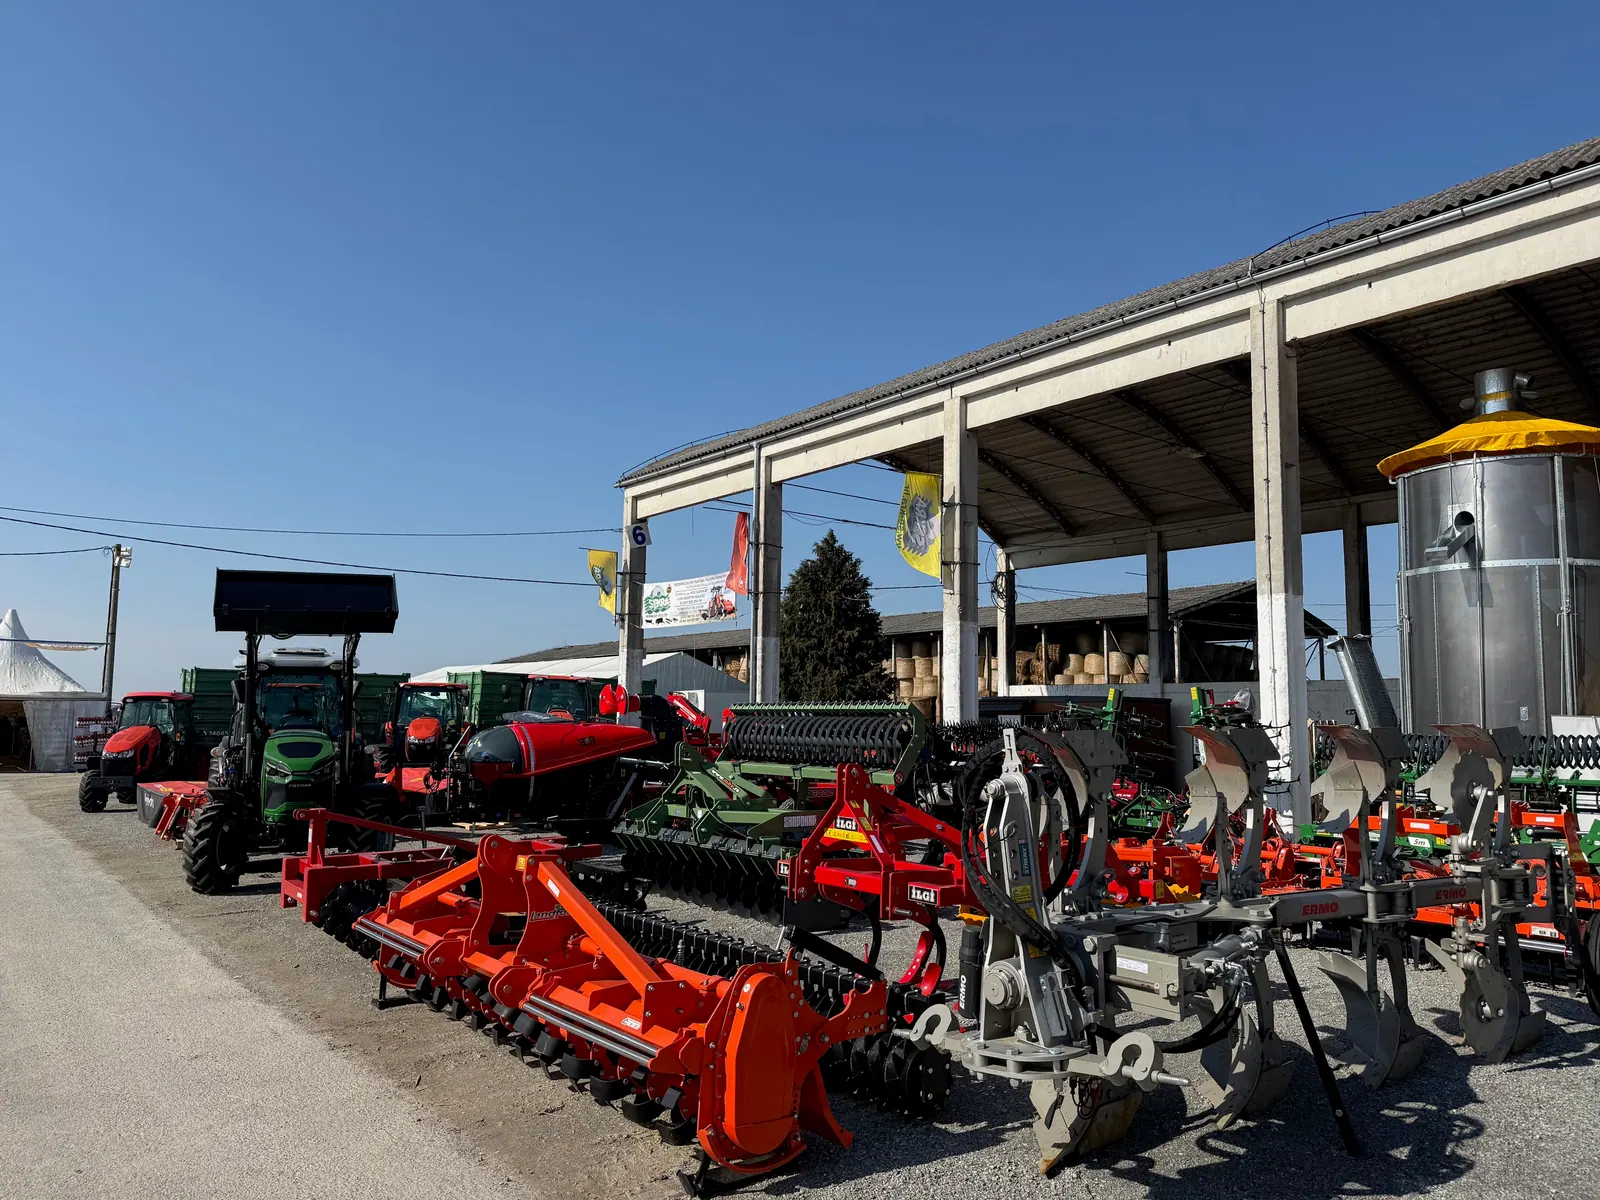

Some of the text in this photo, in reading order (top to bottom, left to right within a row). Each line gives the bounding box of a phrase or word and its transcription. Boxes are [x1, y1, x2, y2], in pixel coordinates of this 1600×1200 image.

[632, 525, 646, 545] 6
[1435, 888, 1467, 900] ERMO
[1302, 902, 1339, 916] ERMO
